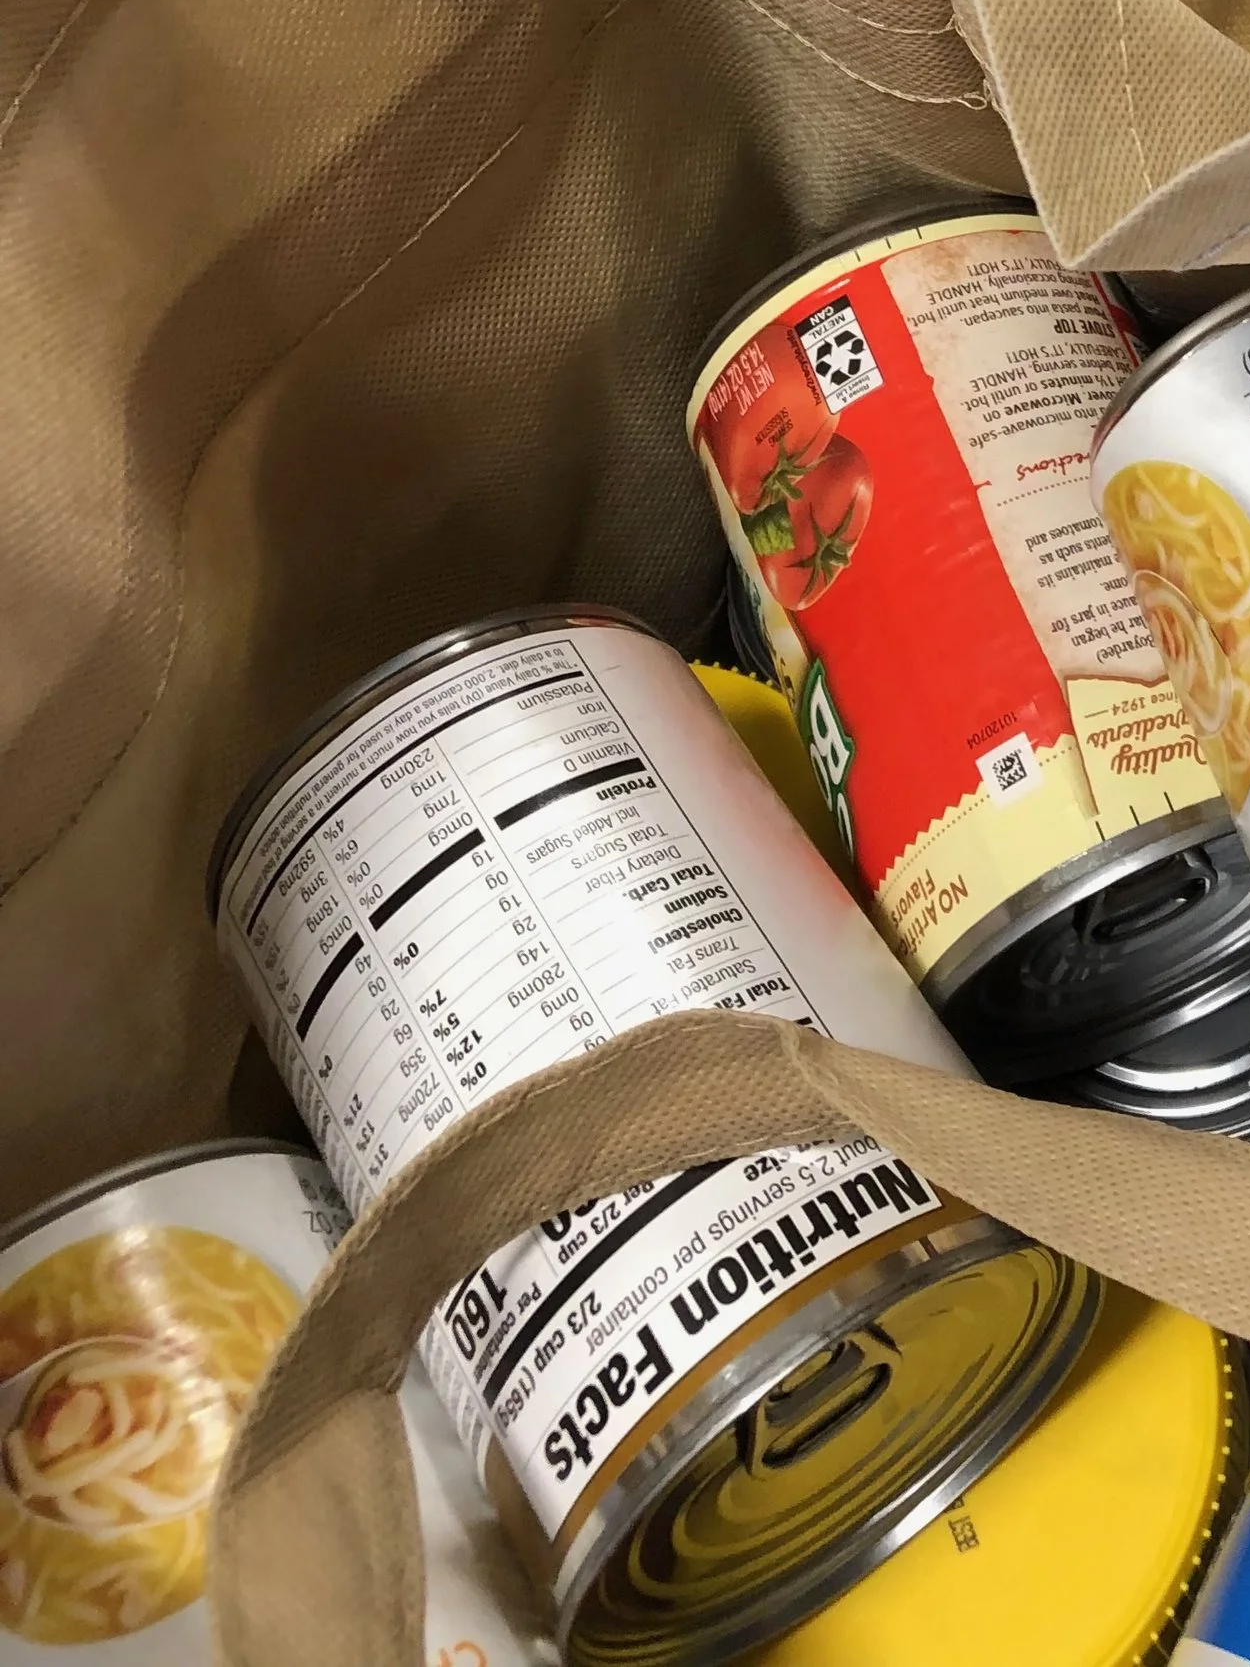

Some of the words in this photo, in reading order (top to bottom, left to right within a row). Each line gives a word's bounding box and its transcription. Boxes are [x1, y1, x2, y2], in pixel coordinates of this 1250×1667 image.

[966, 261, 997, 277] HOT!
[1000, 258, 1024, 272] IT'S
[925, 280, 981, 305] HANDLE
[984, 273, 1057, 289] occasionally.
[969, 294, 999, 309] heat
[1000, 288, 1048, 302] medium
[809, 306, 835, 326] CAN
[906, 311, 935, 329] hot,
[936, 300, 967, 320] until
[959, 305, 1024, 327] saucepan.
[1026, 304, 1050, 315] into
[808, 313, 846, 339] METAL
[1053, 318, 1077, 334] TOP
[1078, 319, 1115, 337] STOVE
[1005, 347, 1036, 364] HOT!
[1039, 344, 1063, 358] IT'S
[1064, 342, 1126, 357] CAREFULLY,
[725, 361, 744, 391] OZ
[1028, 359, 1076, 374] serving.
[1078, 358, 1113, 372] before
[969, 366, 1027, 392] HANDLE
[1024, 382, 1038, 393] or
[1039, 375, 1093, 389] minutes
[733, 384, 755, 416] WT
[960, 395, 989, 412] hot.
[990, 385, 1021, 405] until
[1004, 393, 1080, 416] Microwave
[982, 410, 1001, 423] on
[1073, 407, 1098, 420] into
[969, 411, 1072, 448] microwave-safe
[1048, 514, 1103, 539] tomatoes
[1024, 533, 1048, 552] and
[1054, 542, 1084, 562] such
[1054, 555, 1112, 581] maintains
[1037, 574, 1055, 588] its
[1070, 604, 1096, 625] jars
[1070, 626, 1109, 647] began
[460, 687, 484, 706] (DV)
[484, 676, 514, 694] Value
[517, 682, 594, 710] Potassium
[576, 700, 607, 715] Iron
[1112, 696, 1146, 715] 1924
[559, 720, 620, 745] Calcium
[966, 710, 1017, 750] 10120704
[563, 758, 577, 773] D
[578, 742, 635, 765] Vitamin
[379, 747, 434, 789] 230mg
[596, 776, 656, 801] Protein
[422, 789, 460, 819] 7mg
[319, 816, 349, 845] 4%
[427, 812, 473, 847] 0mcg
[572, 814, 613, 842] Added
[627, 824, 668, 846] Total
[334, 839, 359, 864] 6%
[471, 849, 494, 868] 1g
[526, 833, 573, 864] Sugars
[570, 837, 628, 870] Sugars
[626, 844, 681, 872] Dietary
[278, 848, 316, 897] 592mg
[346, 861, 371, 887] 0%
[484, 870, 509, 890] 0g
[585, 866, 626, 893] Fiber
[671, 863, 714, 886] Total
[300, 870, 328, 904] 3mg
[358, 883, 384, 909] 0%
[622, 877, 670, 901] Carb.
[664, 885, 728, 914] Sodium
[885, 869, 936, 928] Flavors
[304, 894, 339, 934] 18mg
[498, 894, 522, 913] 1g
[318, 915, 353, 955] 0mcg
[512, 915, 537, 936] 2g
[648, 908, 743, 953] Cholesterol
[393, 942, 419, 969] 0%
[516, 941, 550, 966] 14g
[695, 936, 739, 961] Trans
[666, 953, 696, 974] Fat
[507, 962, 565, 1008] 280mg
[680, 958, 756, 998] Saturated
[746, 977, 790, 1002] Total
[419, 989, 447, 1017] 7%
[540, 986, 579, 1017] 0mg
[432, 1012, 460, 1040] 5%
[569, 1011, 594, 1032] 0g
[446, 1029, 482, 1065] 12%
[399, 1046, 427, 1078] 35g
[460, 1061, 487, 1090] 0%
[398, 1072, 440, 1123] 720mg
[423, 1096, 454, 1131] 0mg
[798, 1155, 835, 1187] 2.5
[590, 1201, 621, 1235] 2/3
[708, 1176, 795, 1240] servings
[549, 1227, 592, 1266] cup
[672, 1230, 707, 1272] per
[678, 1159, 918, 1334] Nutrition
[517, 1281, 542, 1314] Per
[452, 1270, 507, 1359] 160
[567, 1291, 602, 1335] 2/3
[586, 1267, 668, 1354] container
[533, 1329, 565, 1372] cup
[546, 1328, 671, 1478] Facts
